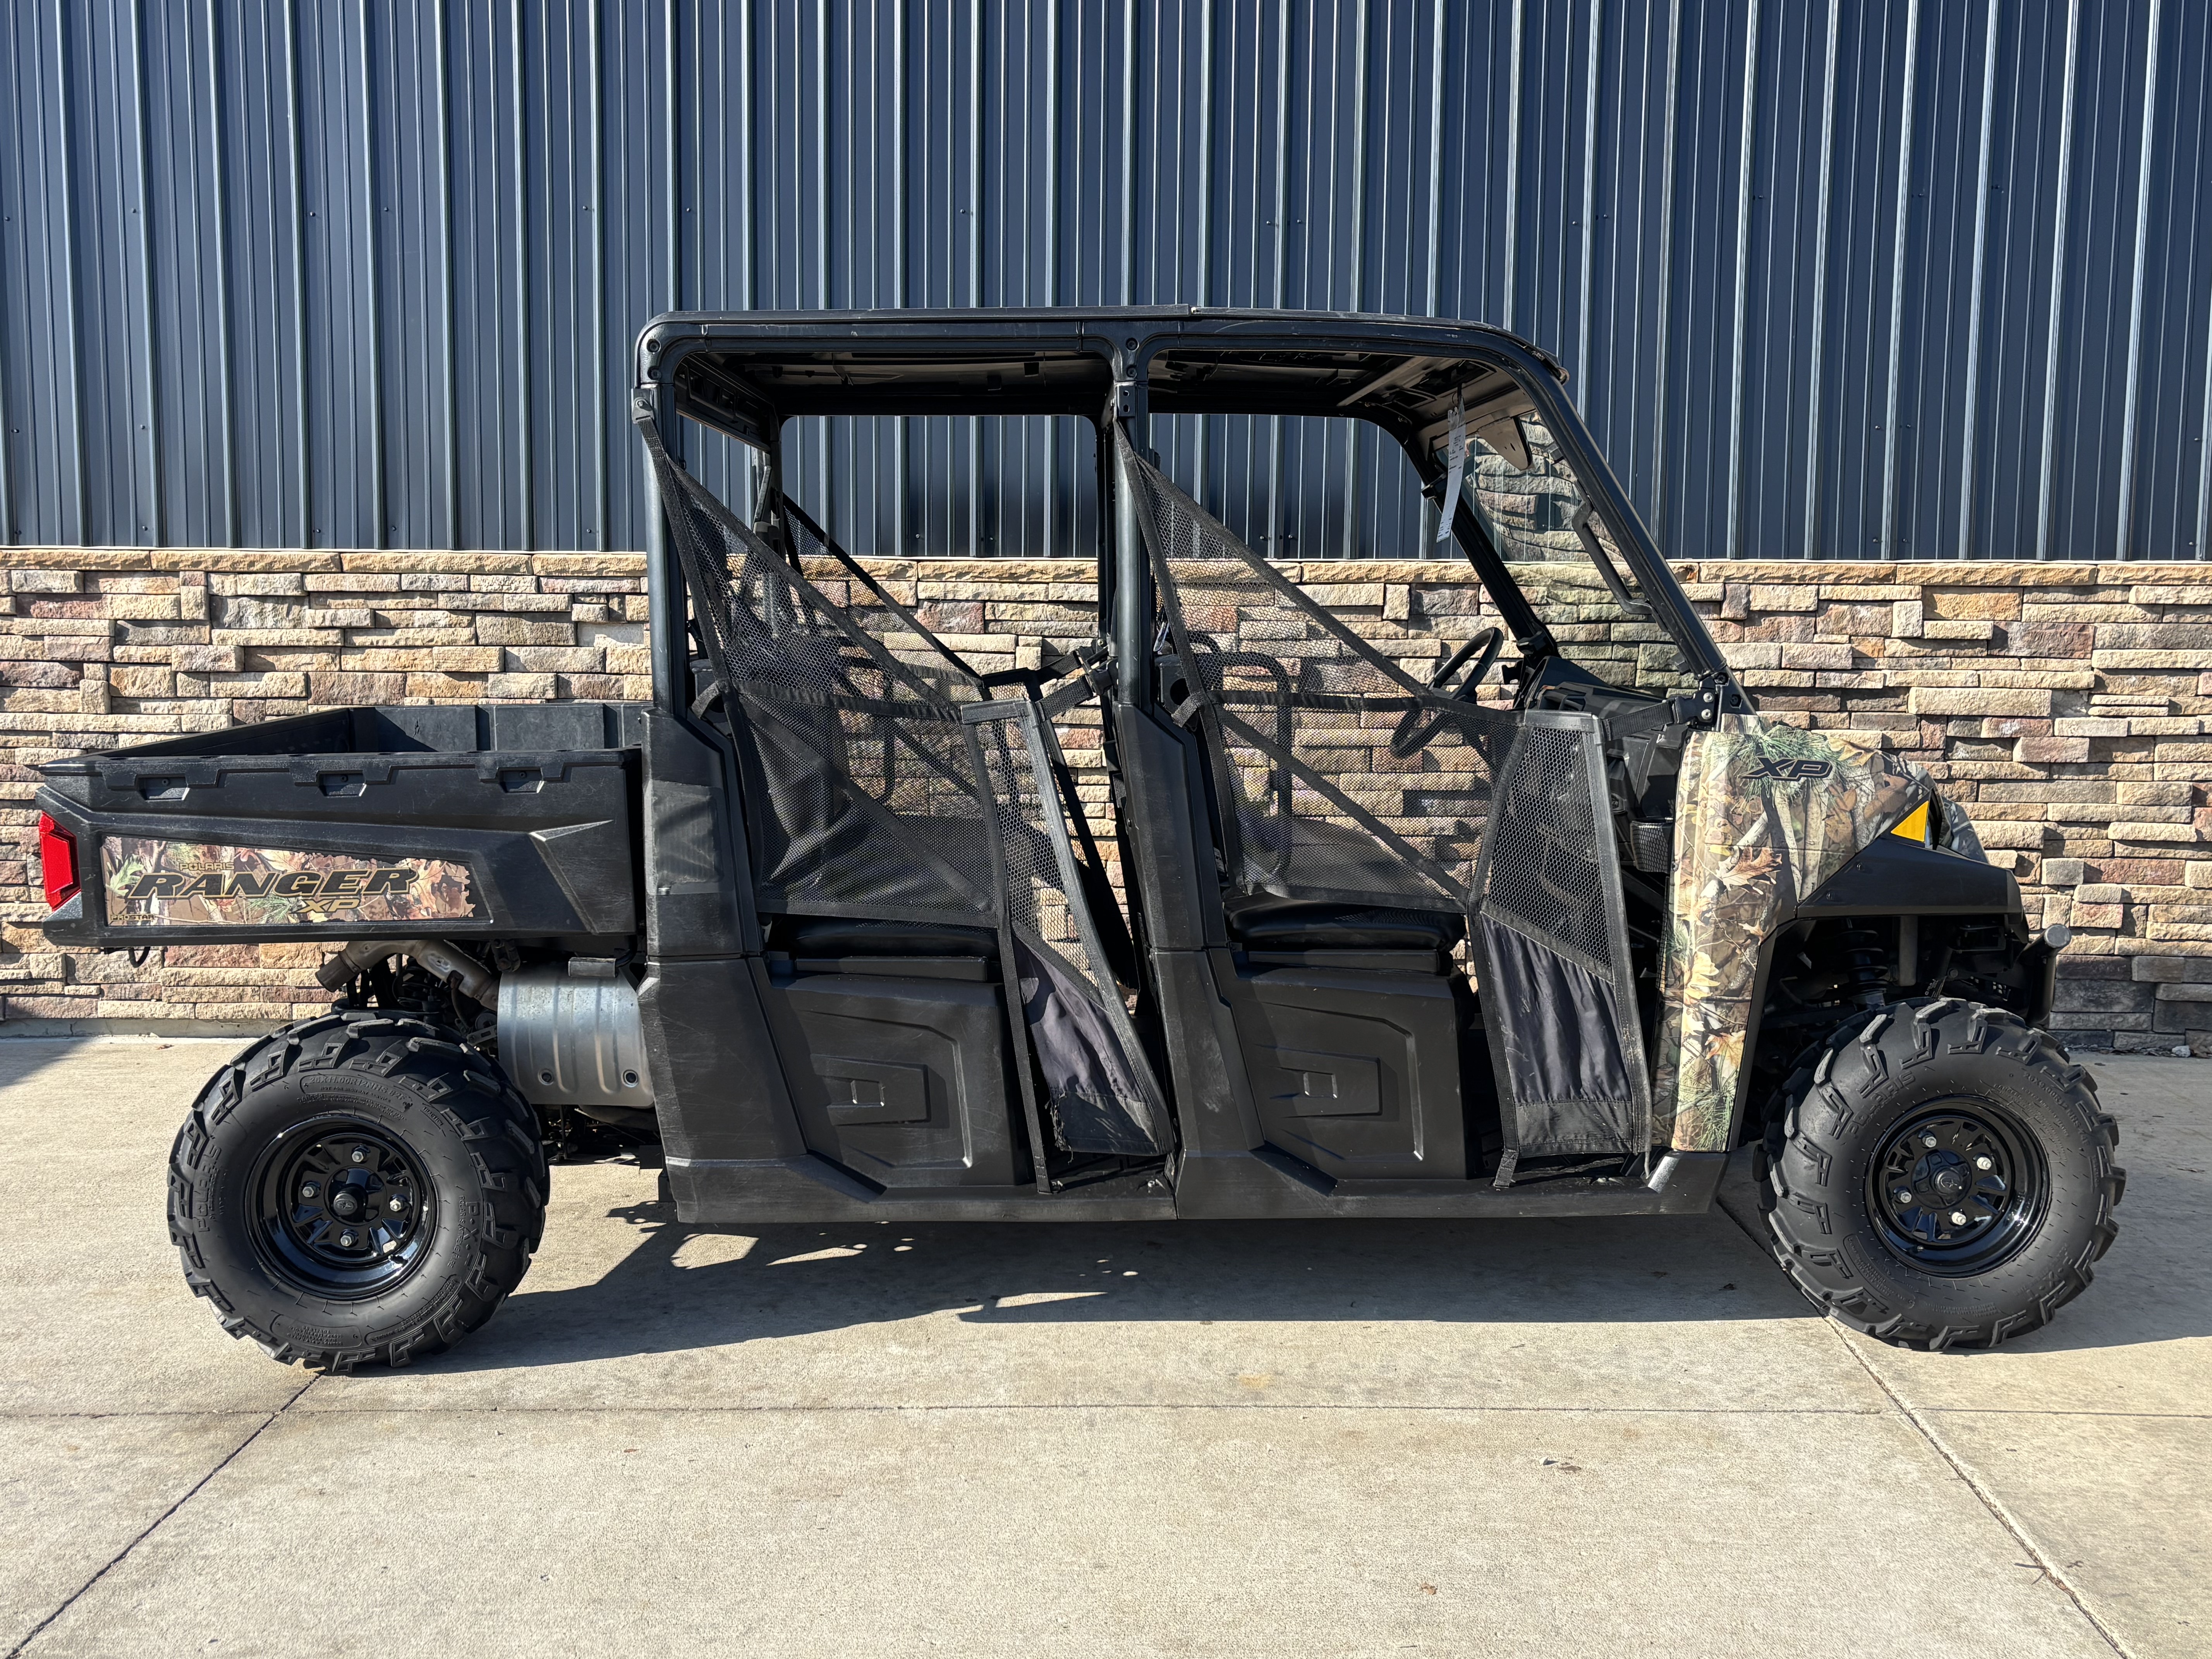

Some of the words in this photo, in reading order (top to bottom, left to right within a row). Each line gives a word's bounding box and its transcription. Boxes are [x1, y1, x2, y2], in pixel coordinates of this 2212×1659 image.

[1737, 756, 1833, 781] XP
[179, 862, 234, 871] POLARIS
[127, 867, 420, 900] RANGER
[290, 897, 362, 913] XP
[1844, 1070, 1916, 1139] POLARIS
[192, 1144, 222, 1232] POLARIS
